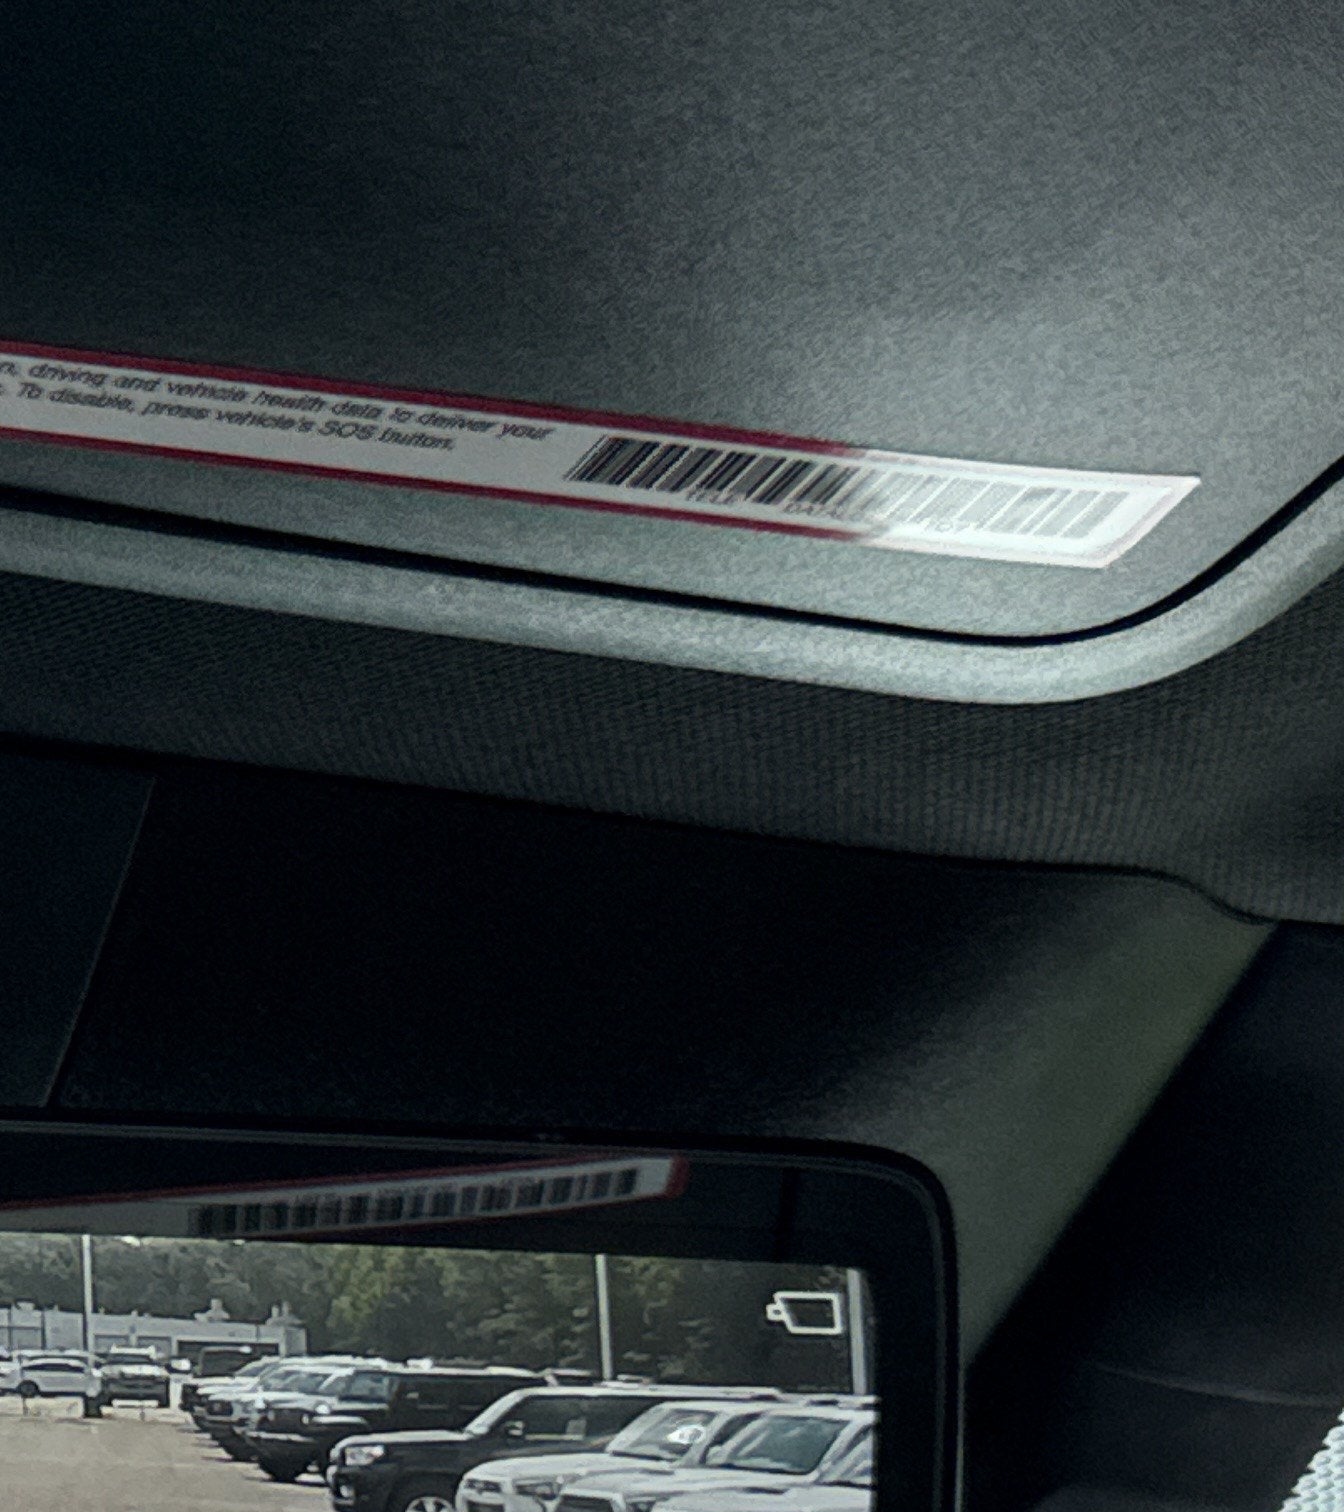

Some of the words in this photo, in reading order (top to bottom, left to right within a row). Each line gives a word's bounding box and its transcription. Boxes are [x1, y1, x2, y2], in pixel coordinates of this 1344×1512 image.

[19, 380, 45, 400] To
[140, 401, 212, 420] press
[214, 408, 315, 433] vehicle's
[317, 419, 379, 440] SOS
[28, 362, 110, 388] driving
[112, 376, 164, 393] and
[166, 381, 250, 403] vehicle
[251, 390, 328, 412] health
[331, 400, 384, 421] data
[386, 407, 416, 422] to
[417, 409, 499, 432] deliver
[499, 422, 557, 440] your
